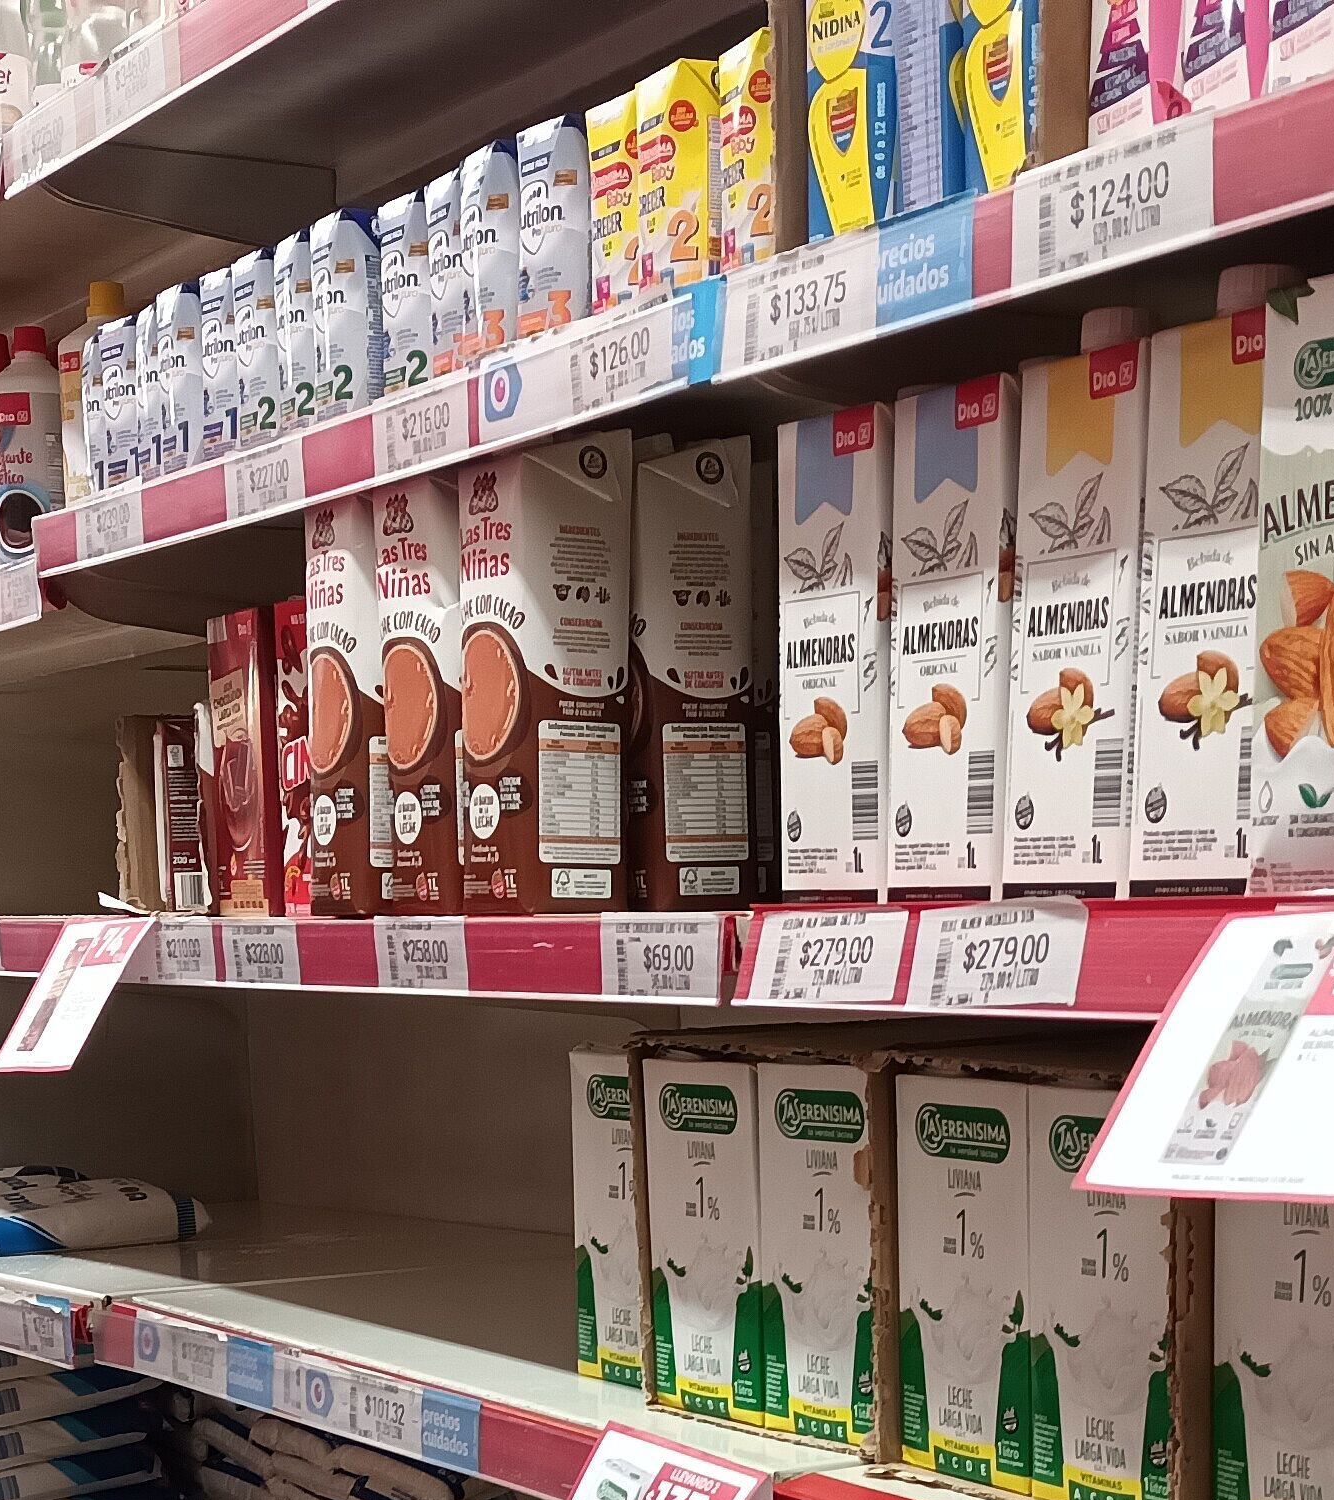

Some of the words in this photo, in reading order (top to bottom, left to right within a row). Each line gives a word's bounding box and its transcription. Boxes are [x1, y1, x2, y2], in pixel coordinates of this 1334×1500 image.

[812, 10, 861, 42] NIDINA
[1069, 162, 1169, 227] $124,00
[770, 271, 847, 325] $133,75
[876, 264, 948, 304] uidados
[406, 351, 428, 385] 2
[590, 328, 649, 378] $126,00
[402, 401, 450, 440] $216,00
[1295, 395, 1332, 421] 100%
[482, 517, 511, 543] Tres
[397, 540, 427, 562] Tres
[1294, 540, 1320, 565] SIN
[377, 568, 430, 599] Niñas
[1159, 575, 1257, 618] ALMENDRAS
[1027, 598, 1109, 638] ALMENDRAS
[786, 634, 855, 669] ALMENDRAS
[902, 617, 978, 655] ALMENDRAS
[402, 940, 448, 963] $258,00
[644, 945, 694, 970] $69,00
[800, 936, 873, 966] $279,00
[964, 933, 1049, 969] $279,00
[422, 1409, 461, 1433] precios
[422, 1430, 468, 1456] cuidados
